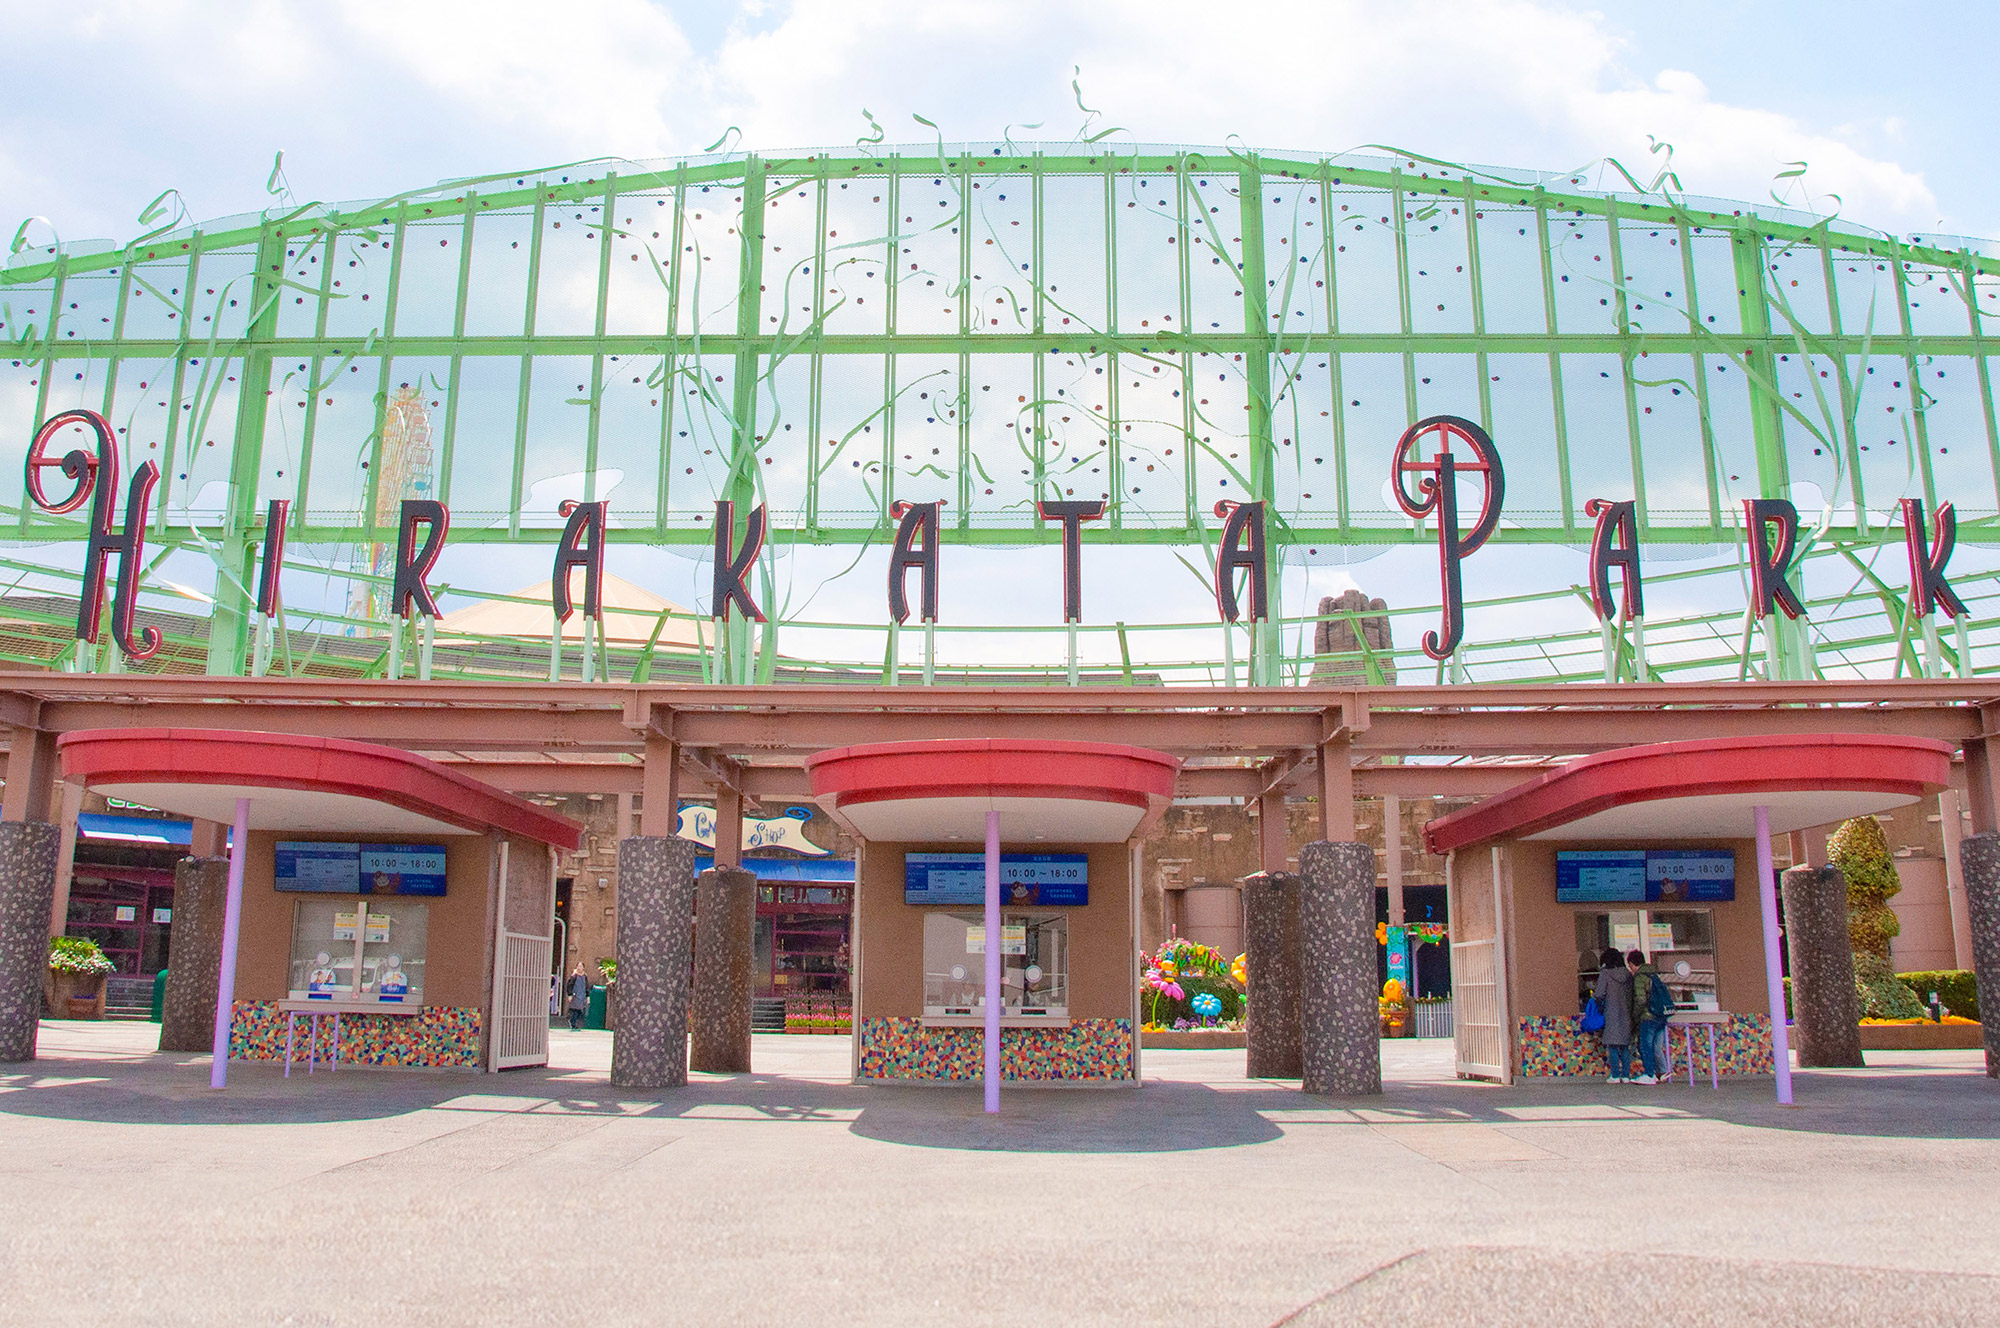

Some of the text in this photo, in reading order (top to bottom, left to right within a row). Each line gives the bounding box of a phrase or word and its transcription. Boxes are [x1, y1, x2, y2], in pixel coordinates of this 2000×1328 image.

[25, 409, 1970, 661] HIRAKATA PARK
[370, 858, 397, 868] 10:00
[410, 859, 437, 869] 18:00
[1008, 869, 1036, 878] 10:00
[1050, 869, 1078, 878] 18:00
[1657, 865, 1684, 874] 10:00
[1698, 865, 1725, 873] 18:00
